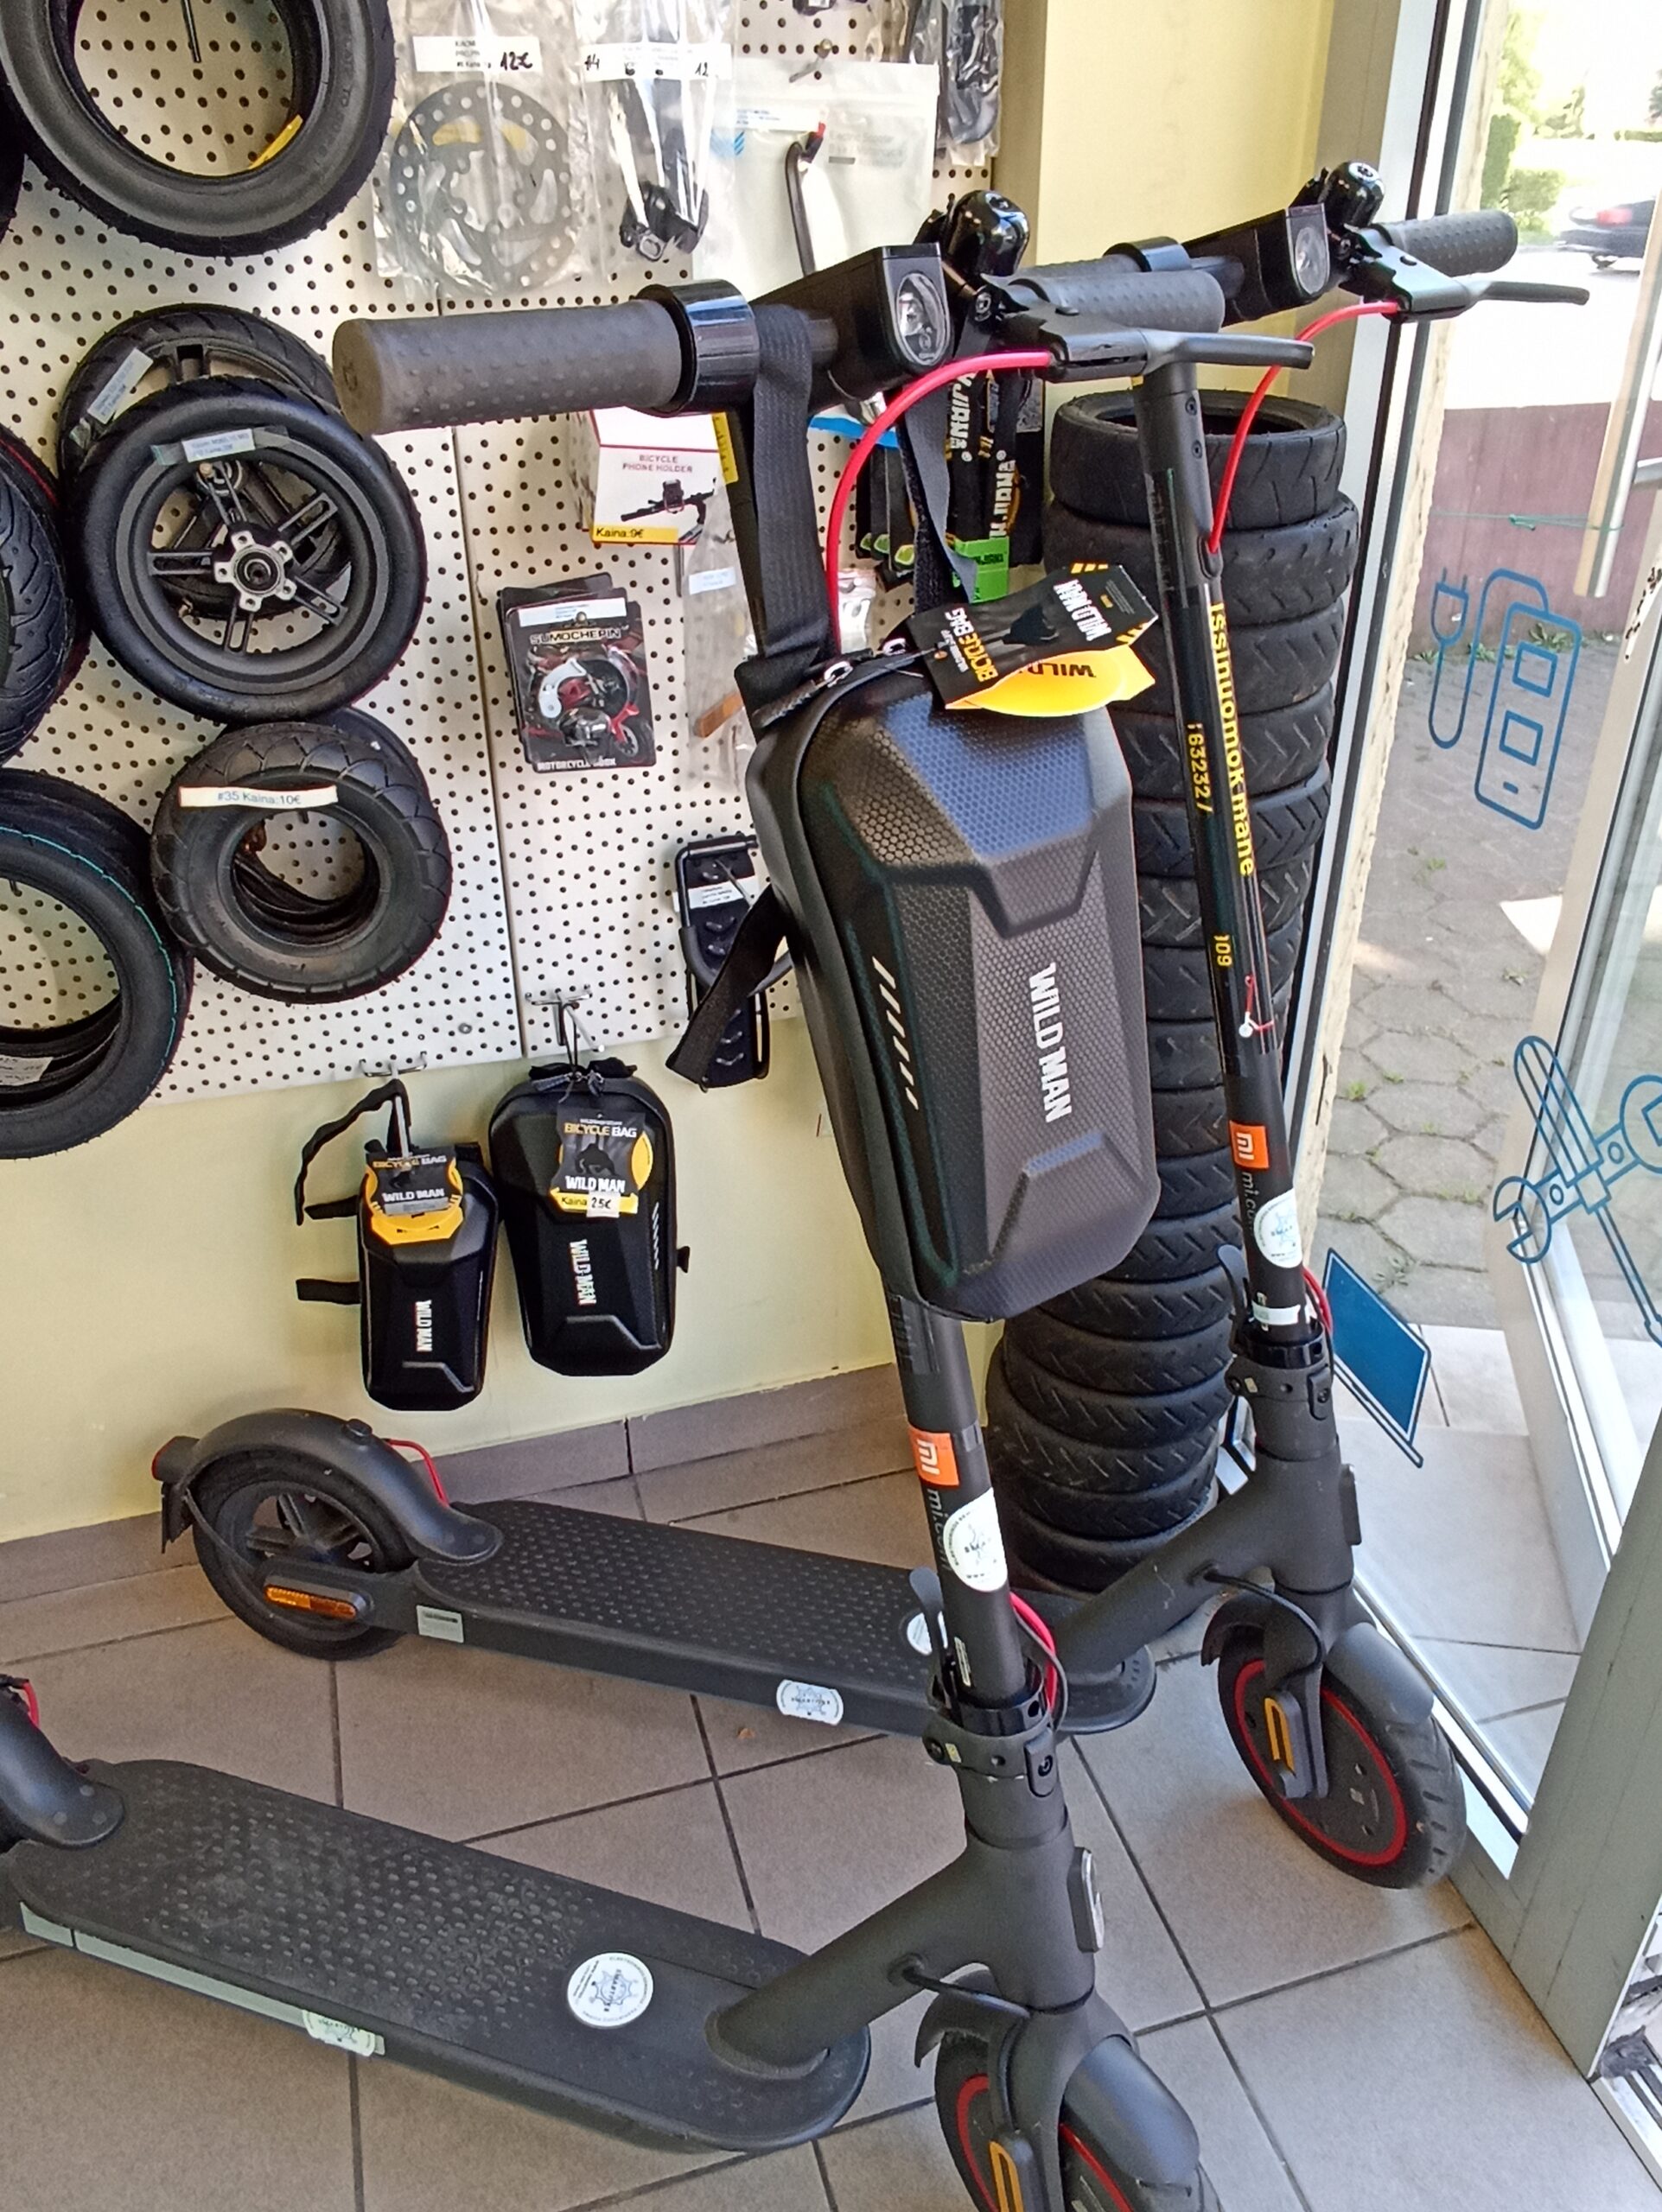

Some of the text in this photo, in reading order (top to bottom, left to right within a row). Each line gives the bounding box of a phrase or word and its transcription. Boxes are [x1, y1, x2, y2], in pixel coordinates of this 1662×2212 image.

[622, 463, 693, 474] PHONE HOLDER
[639, 454, 678, 464] BICYCLE
[945, 607, 975, 638] BAG
[958, 632, 998, 683] BICYCLE
[1232, 794, 1256, 876] mane
[1028, 961, 1073, 1123] WILD MAN
[564, 1122, 611, 1137] BICYCLE
[611, 1126, 638, 1139] BAG
[421, 1154, 448, 1166] BAG
[381, 1187, 445, 1204] WILD MAN
[564, 1174, 627, 1193] WILD MAN
[570, 1238, 597, 1306] WILD MAN
[415, 1299, 433, 1352] WILD MAN
